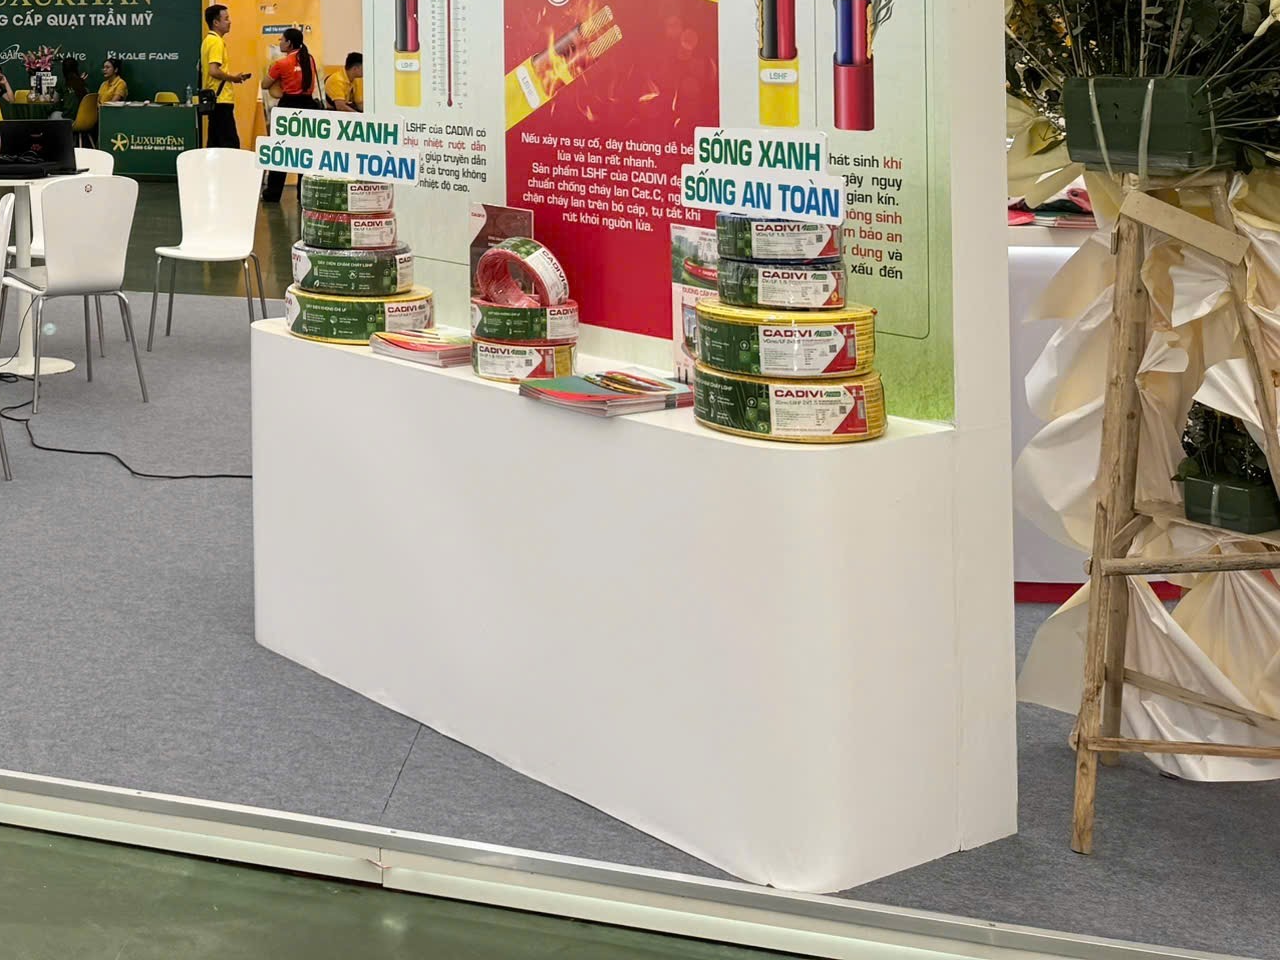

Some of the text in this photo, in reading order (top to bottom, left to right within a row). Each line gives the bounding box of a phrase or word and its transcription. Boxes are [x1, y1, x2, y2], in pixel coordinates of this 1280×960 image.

[11, 9, 43, 27] CẤP
[47, 13, 86, 29] QUẠT
[88, 7, 131, 26] TRẦN
[131, 9, 153, 26] MỸ
[118, 52, 179, 61] KALE FANS
[275, 111, 398, 145] SỐNG XANH
[405, 122, 427, 133] LSHF
[476, 128, 487, 138] có
[521, 132, 623, 153] Nếu ra sự dây
[699, 129, 821, 172] SỐNG XANH
[259, 140, 415, 180] SỐNG AN TOÀN
[574, 151, 585, 162] và
[587, 152, 602, 163] lan
[623, 156, 658, 168] nhanh.
[853, 155, 879, 168] sinh
[438, 167, 460, 180] trong
[581, 167, 607, 179] LSHF
[631, 172, 667, 186] CADIVI
[453, 183, 470, 193] cao.
[588, 183, 629, 198] cháy lan
[871, 176, 903, 191] nguy
[684, 169, 839, 218] SỐNG AN TOÀN
[846, 190, 899, 206] gian kín.
[571, 196, 701, 221] lan trên khi
[876, 210, 902, 225] sinh
[755, 224, 800, 232] CADIVI
[859, 226, 883, 240] bảo
[886, 233, 902, 243] an
[851, 244, 883, 262] dụng
[888, 249, 903, 261] và
[541, 249, 566, 285] CADIVI
[851, 262, 903, 280] xấu đến
[762, 271, 807, 280] CADIVI
[387, 305, 418, 313] CADIVI
[479, 345, 510, 355] CADIVI
[774, 389, 823, 398] CADIVI
